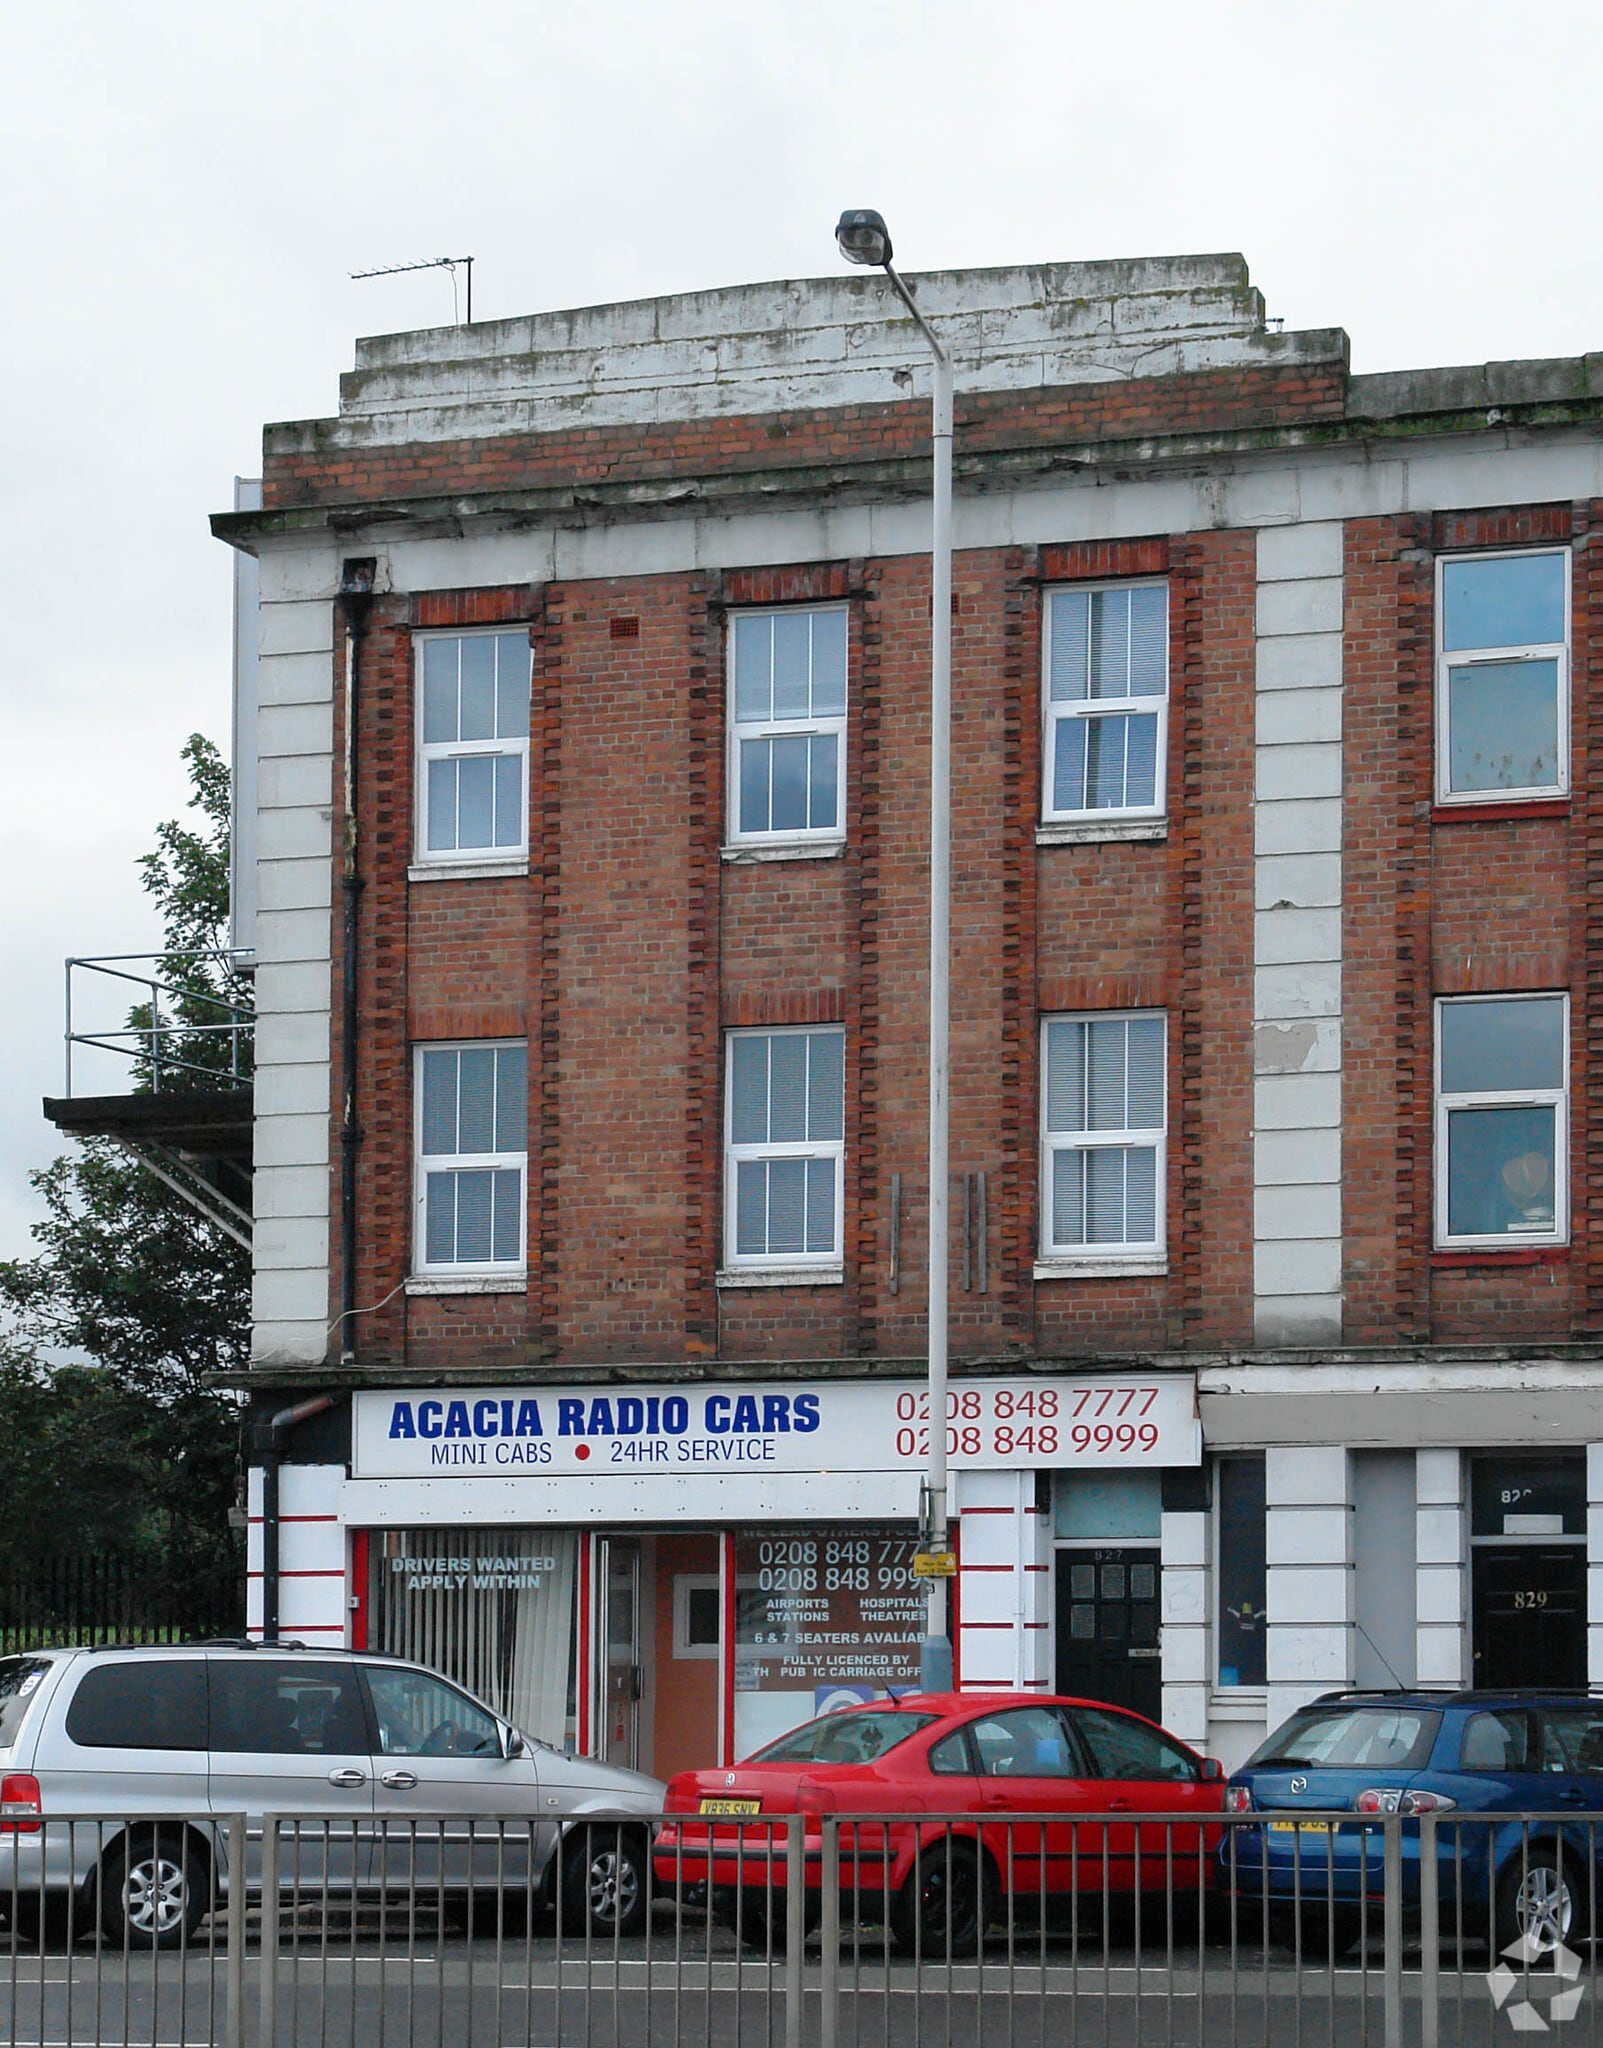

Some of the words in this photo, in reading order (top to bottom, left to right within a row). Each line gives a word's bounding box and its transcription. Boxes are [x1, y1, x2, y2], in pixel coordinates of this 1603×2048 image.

[993, 1390, 1059, 1419] 848
[1071, 1388, 1159, 1418] 7777
[389, 1400, 543, 1438] ACACIA
[558, 1396, 689, 1436] RADIO
[705, 1394, 820, 1434] CARS
[993, 1425, 1058, 1454] 848
[1071, 1423, 1159, 1453] 9999
[431, 1443, 488, 1465] MINI
[495, 1442, 552, 1463] CABS
[611, 1440, 669, 1462] 24HR
[677, 1438, 776, 1461] SERVICE
[759, 1541, 818, 1565] 0208
[825, 1541, 870, 1565] 848
[878, 1541, 921, 1564] 777
[392, 1558, 471, 1572] DRIVERS
[477, 1557, 555, 1572] WANTED
[408, 1576, 467, 1590] APPLY
[473, 1575, 540, 1589] WITHIN
[759, 1567, 818, 1591] 0208
[825, 1567, 870, 1590] 848
[877, 1566, 926, 1590] 999
[766, 1598, 829, 1609] AIRPORTS
[860, 1597, 928, 1608] HOSPITALS
[1514, 1591, 1548, 1608] 829
[766, 1612, 830, 1622] STATIONS
[860, 1611, 927, 1621] THEATRES
[754, 1632, 764, 1644] 6
[767, 1632, 778, 1643] &
[782, 1632, 790, 1643] 7
[794, 1632, 860, 1644] SEATERS
[863, 1632, 927, 1644] AVALIAB
[783, 1655, 823, 1665] FULLY
[826, 1655, 889, 1665] LICENCED
[892, 1655, 910, 1664] BY
[829, 1667, 894, 1677] CARRIAGE
[897, 1667, 922, 1677] OFF
